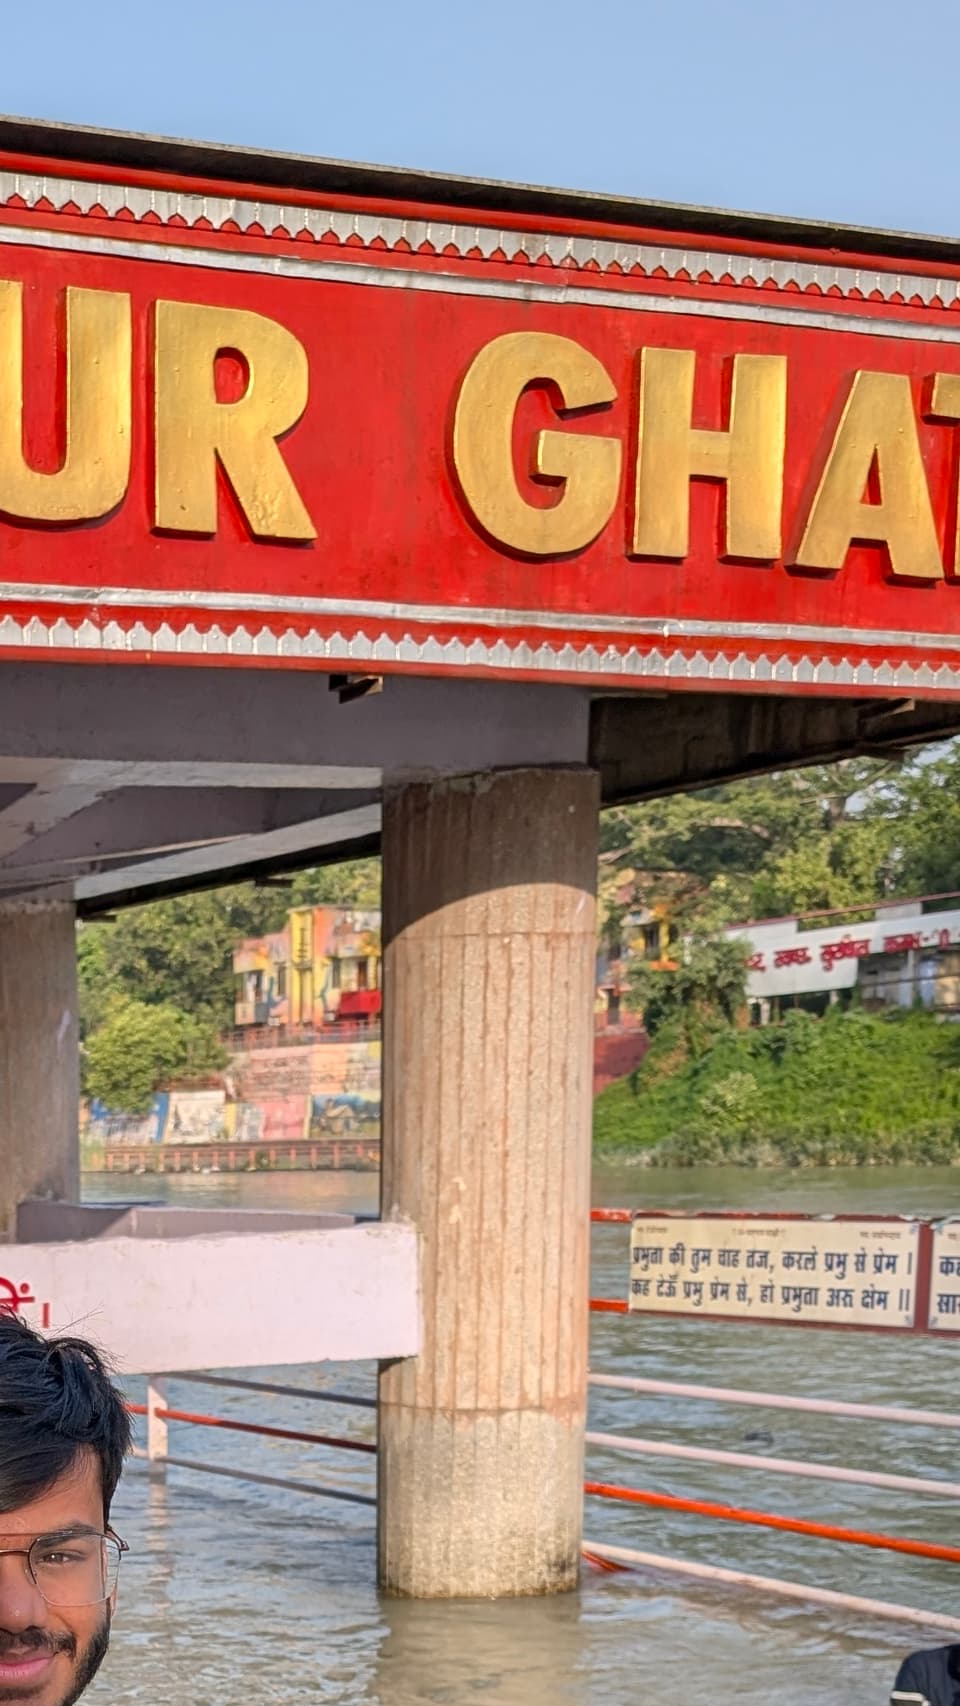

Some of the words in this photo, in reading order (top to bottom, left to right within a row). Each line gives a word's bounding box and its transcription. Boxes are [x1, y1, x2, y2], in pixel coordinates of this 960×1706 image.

[633, 1247, 664, 1271] प्रभुता
[669, 1242, 686, 1266] की
[690, 1248, 712, 1273] तुम
[782, 1246, 818, 1271] करले
[824, 1253, 848, 1279] प्रभु
[854, 1247, 868, 1273] से
[873, 1248, 898, 1275] प्रेम
[631, 1280, 651, 1296] कह
[683, 1281, 704, 1306] प्रभु
[710, 1276, 730, 1300] प्रेम
[759, 1278, 775, 1304] हो
[781, 1286, 820, 1312] प्रभुता
[862, 1283, 889, 1310] क्षेम
